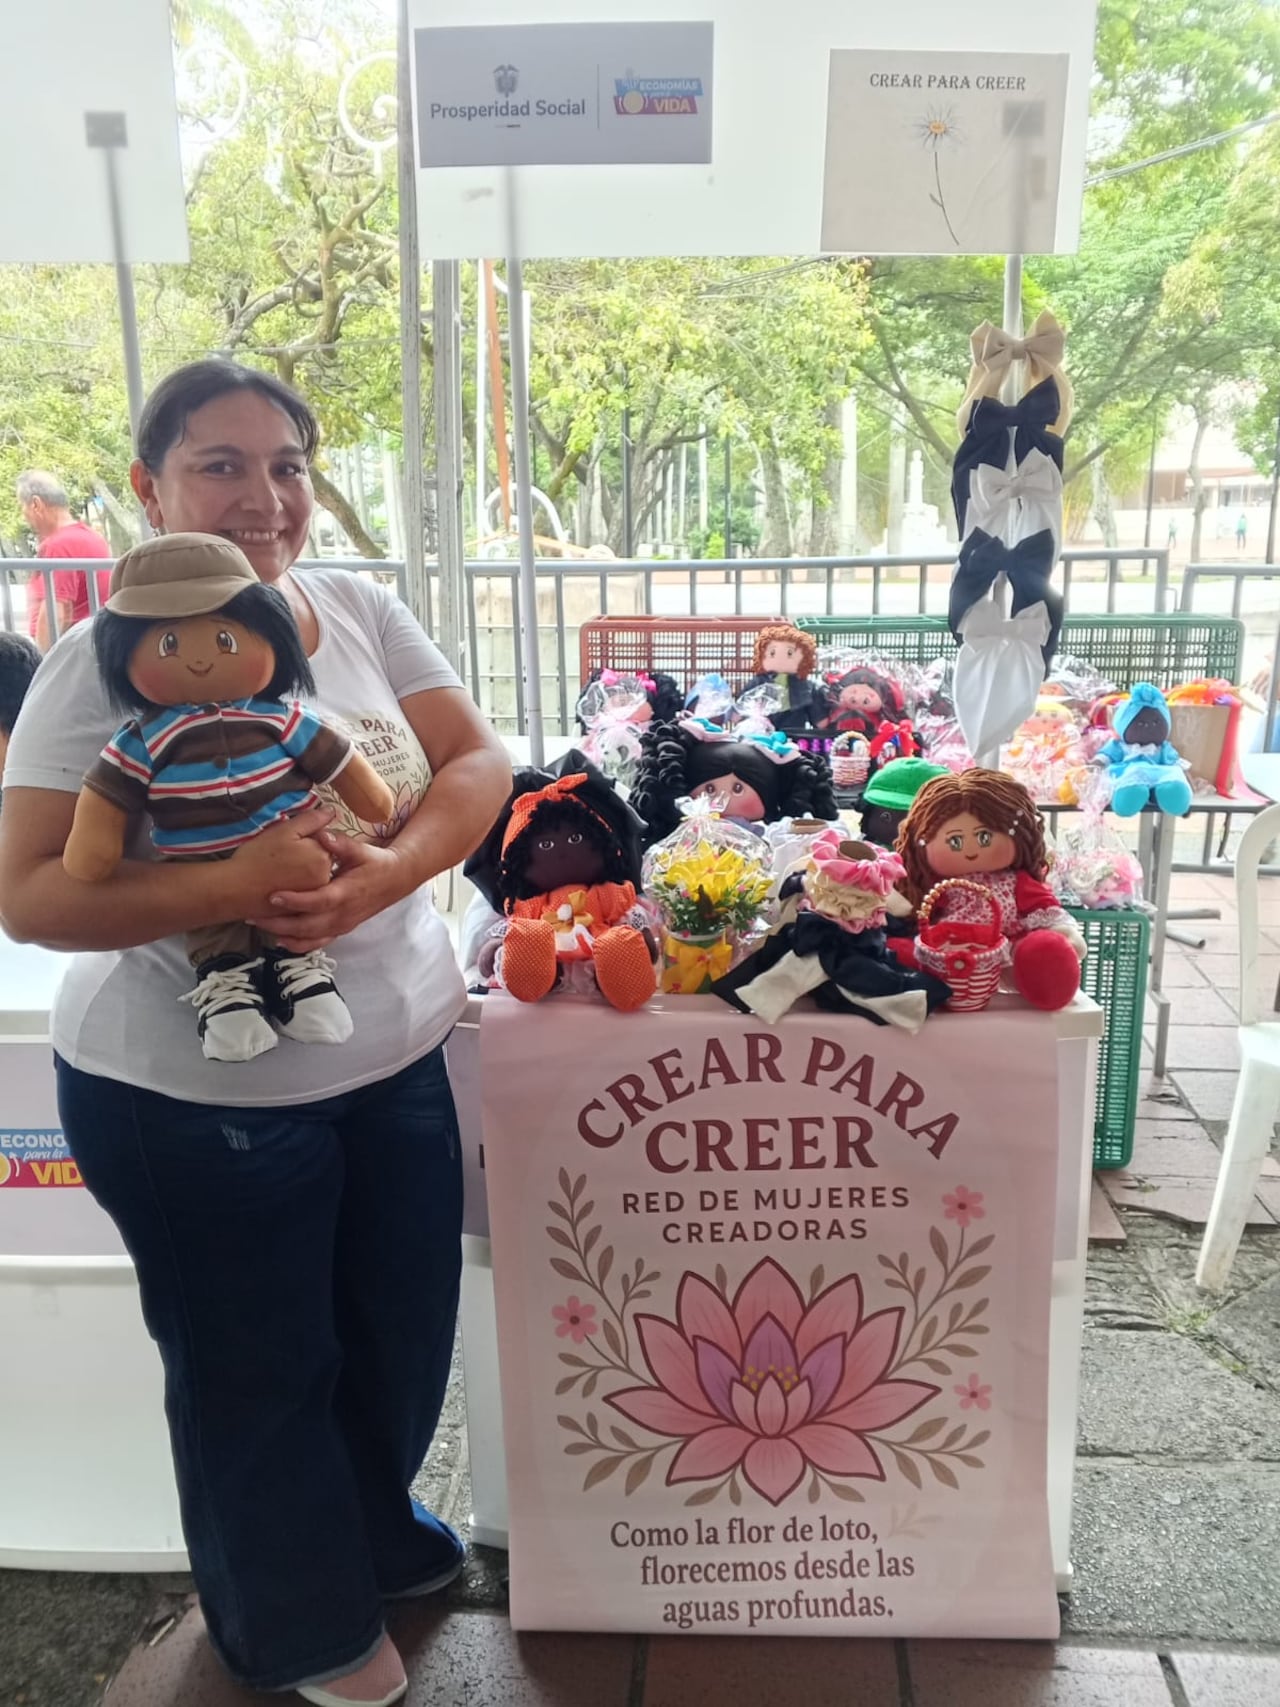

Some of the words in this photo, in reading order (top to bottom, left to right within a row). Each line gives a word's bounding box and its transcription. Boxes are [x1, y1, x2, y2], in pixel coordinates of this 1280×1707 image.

[869, 73, 922, 88] CREAR
[927, 74, 970, 89] PARA
[976, 75, 1026, 91] CREER
[430, 101, 530, 121] Prosperidad
[536, 99, 585, 116] Social
[654, 98, 691, 112] VIDA
[360, 719, 407, 741] PARA
[355, 735, 398, 757] EER
[577, 1033, 786, 1148] CREAR
[800, 1036, 960, 1160] PARA
[0, 1134, 67, 1148] ECONO
[645, 1116, 878, 1174] CREER
[29, 1162, 83, 1185] VID
[622, 1191, 685, 1214] RED
[700, 1190, 739, 1211] DE
[754, 1186, 909, 1211] MUJERES
[662, 1218, 868, 1244] CREADORAS
[610, 1521, 688, 1548] Como
[695, 1518, 720, 1545] la
[727, 1517, 775, 1544] flor
[782, 1516, 813, 1542] de
[820, 1515, 878, 1543] loto,
[641, 1555, 787, 1585] florecemos
[794, 1550, 870, 1580] desde
[876, 1548, 915, 1577] las
[663, 1600, 740, 1629] aguas
